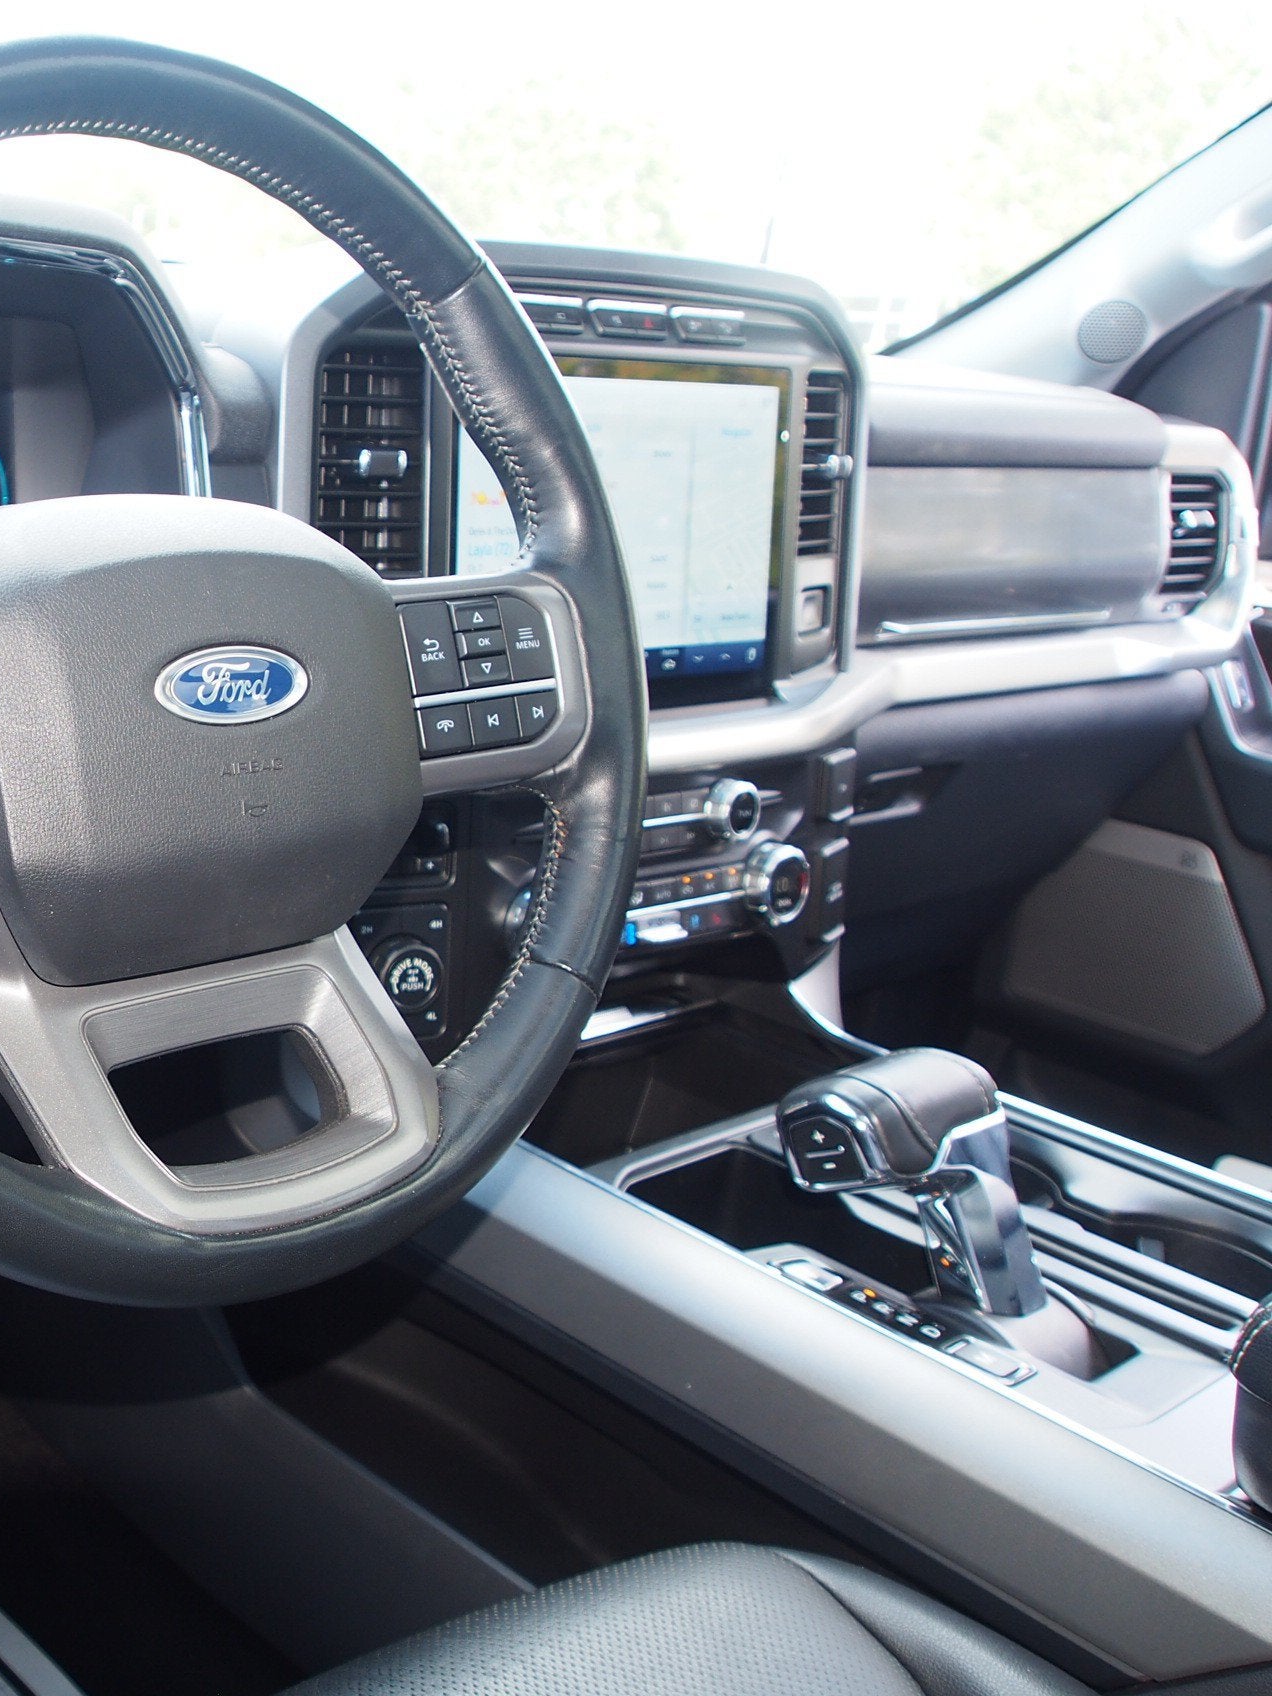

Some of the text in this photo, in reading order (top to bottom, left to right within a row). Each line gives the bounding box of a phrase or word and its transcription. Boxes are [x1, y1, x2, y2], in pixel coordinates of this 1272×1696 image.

[516, 640, 540, 649] MENU
[421, 652, 445, 662] BACK
[197, 662, 271, 705] Ford
[430, 920, 443, 928] 4H
[390, 957, 434, 984] DRIVE MODE
[401, 982, 424, 990] PUSH
